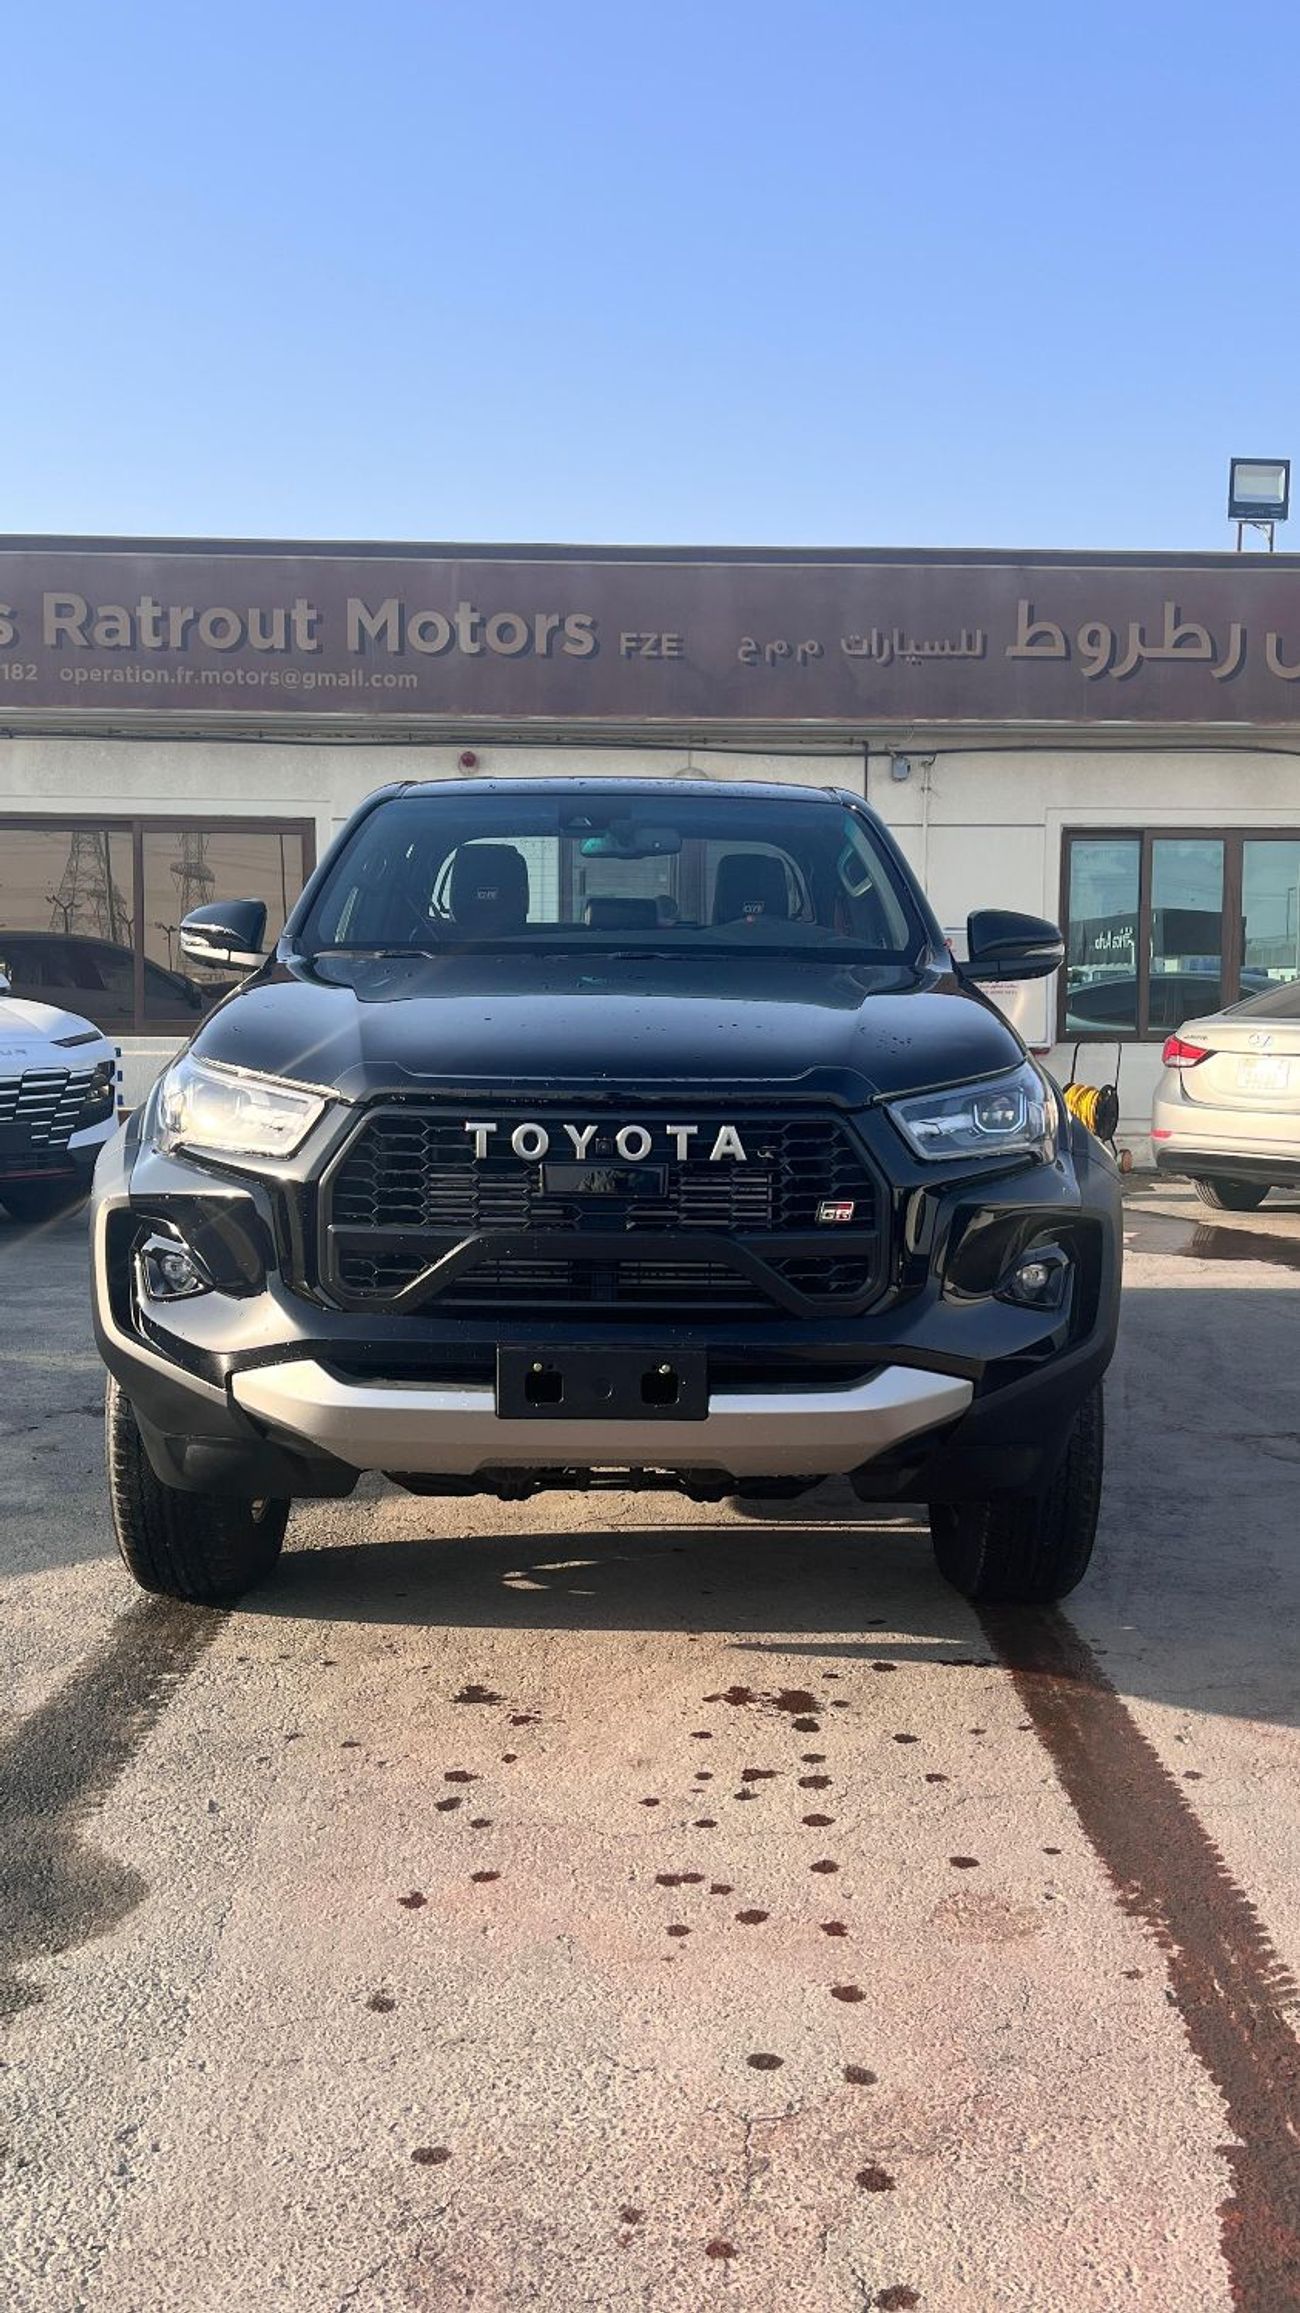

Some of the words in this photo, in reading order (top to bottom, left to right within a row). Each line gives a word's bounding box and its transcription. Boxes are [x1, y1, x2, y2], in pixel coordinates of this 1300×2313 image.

[42, 592, 319, 652] Ratrout
[346, 598, 597, 657] Motors
[619, 632, 681, 658] FZE
[1005, 599, 1242, 680] رطروط
[841, 627, 985, 665] للسيارات
[60, 665, 419, 690] operation.fr.motors@gmail.com
[465, 1122, 747, 1161] TOYOTA
